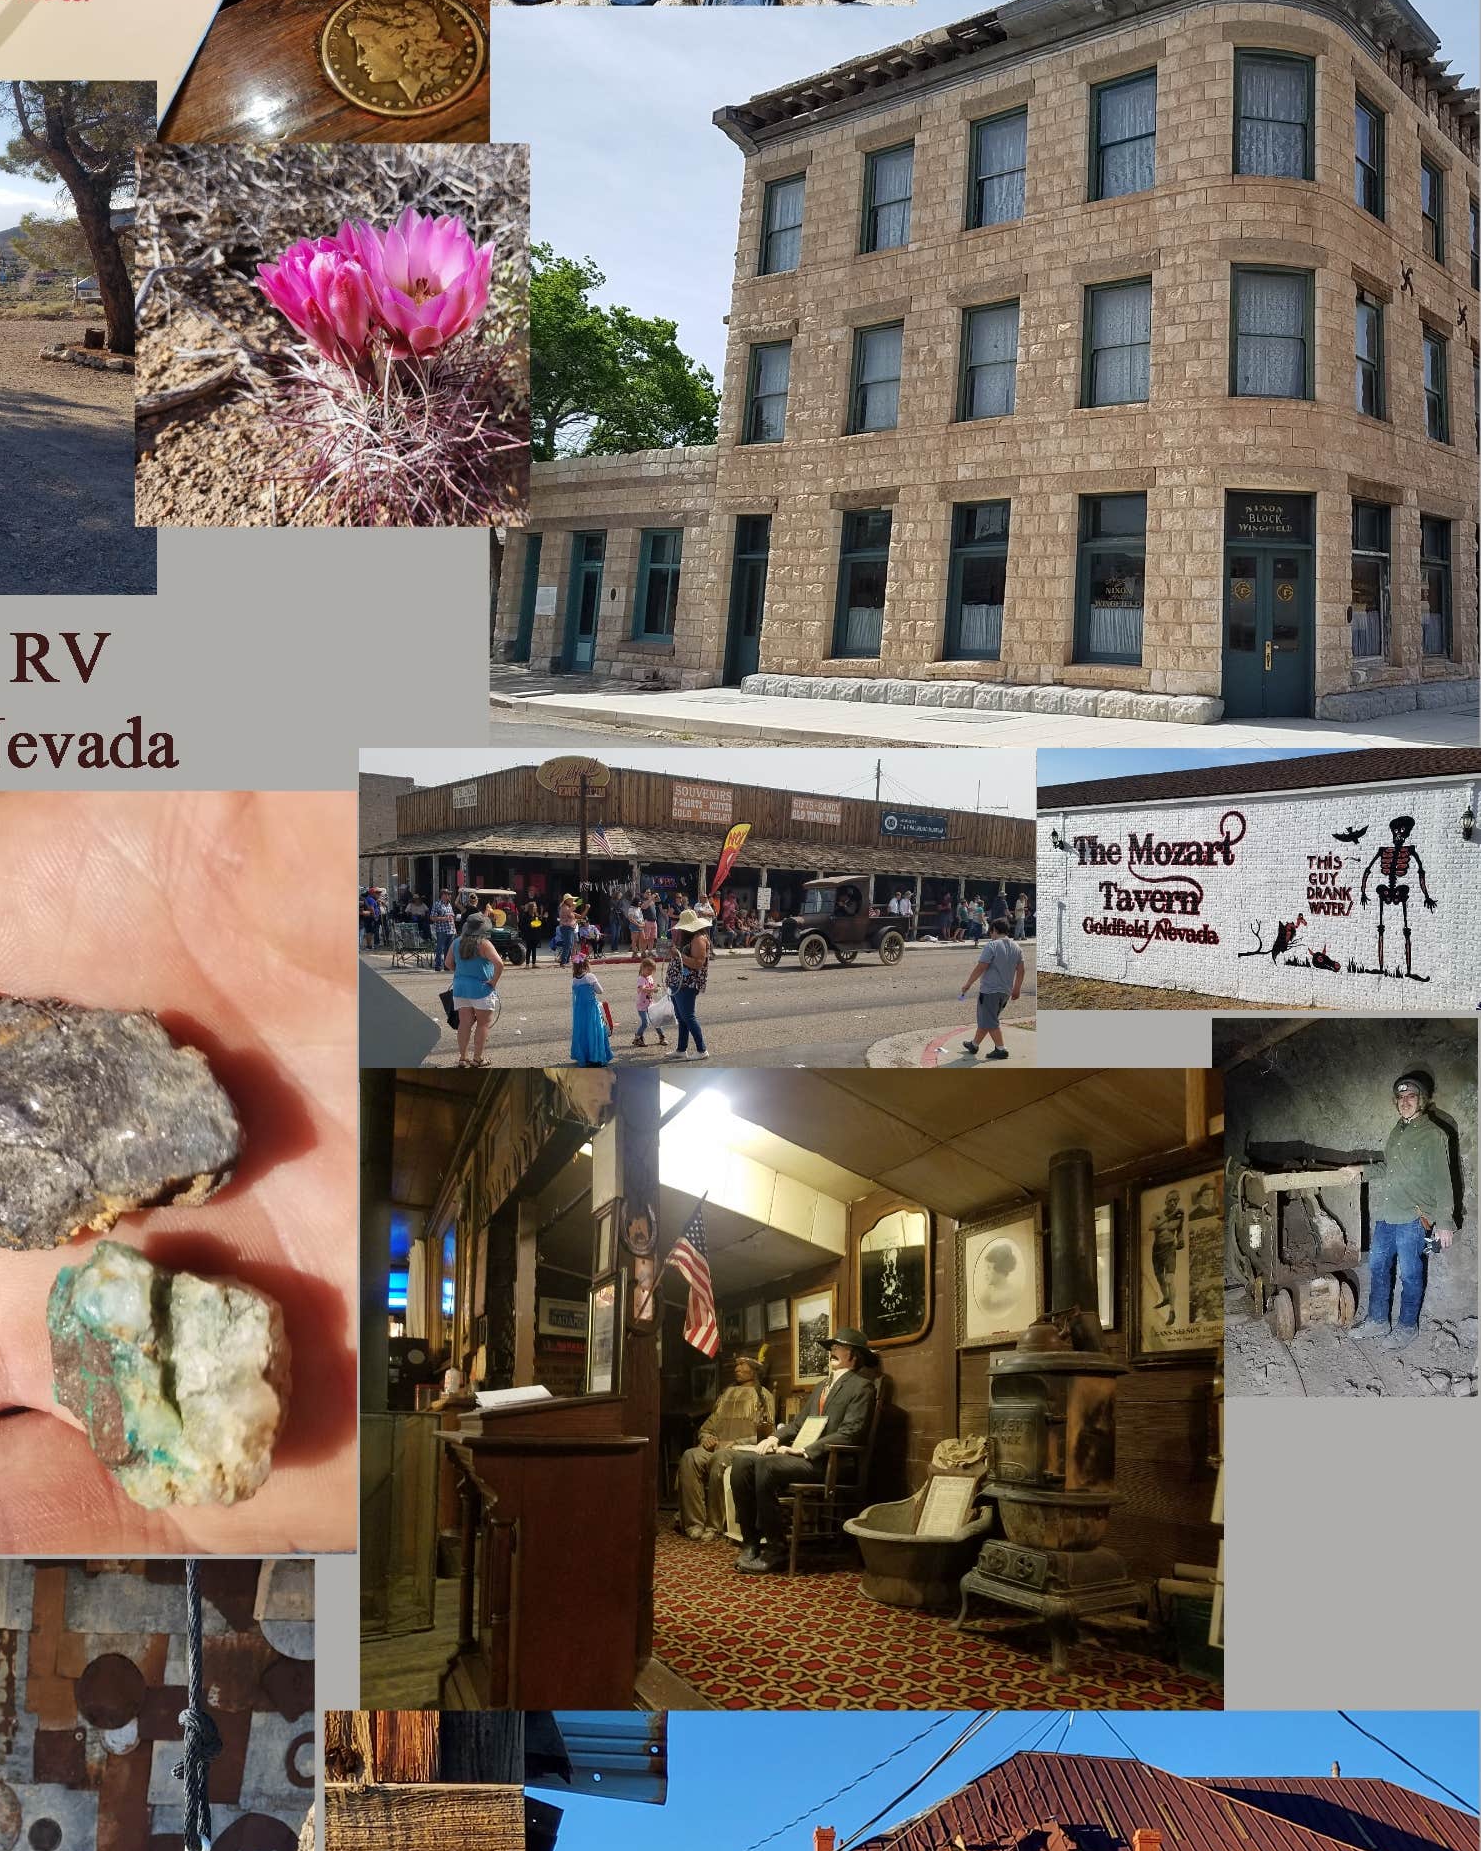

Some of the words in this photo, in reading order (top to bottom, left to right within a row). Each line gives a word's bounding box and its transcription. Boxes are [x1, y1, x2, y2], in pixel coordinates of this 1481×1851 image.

[417, 86, 453, 108] 1900
[1246, 504, 1284, 513] NIXON
[1249, 514, 1283, 524] BLOCK
[675, 786, 733, 801] SOUVENIRS
[673, 808, 691, 818] GOLD
[1073, 835, 1122, 866] The
[1128, 811, 1246, 866] Mozart
[1309, 873, 1338, 886] GUY
[1099, 880, 1203, 915] Tavern
[1306, 887, 1352, 902] DRANK
[1151, 918, 1219, 946] Nevada
